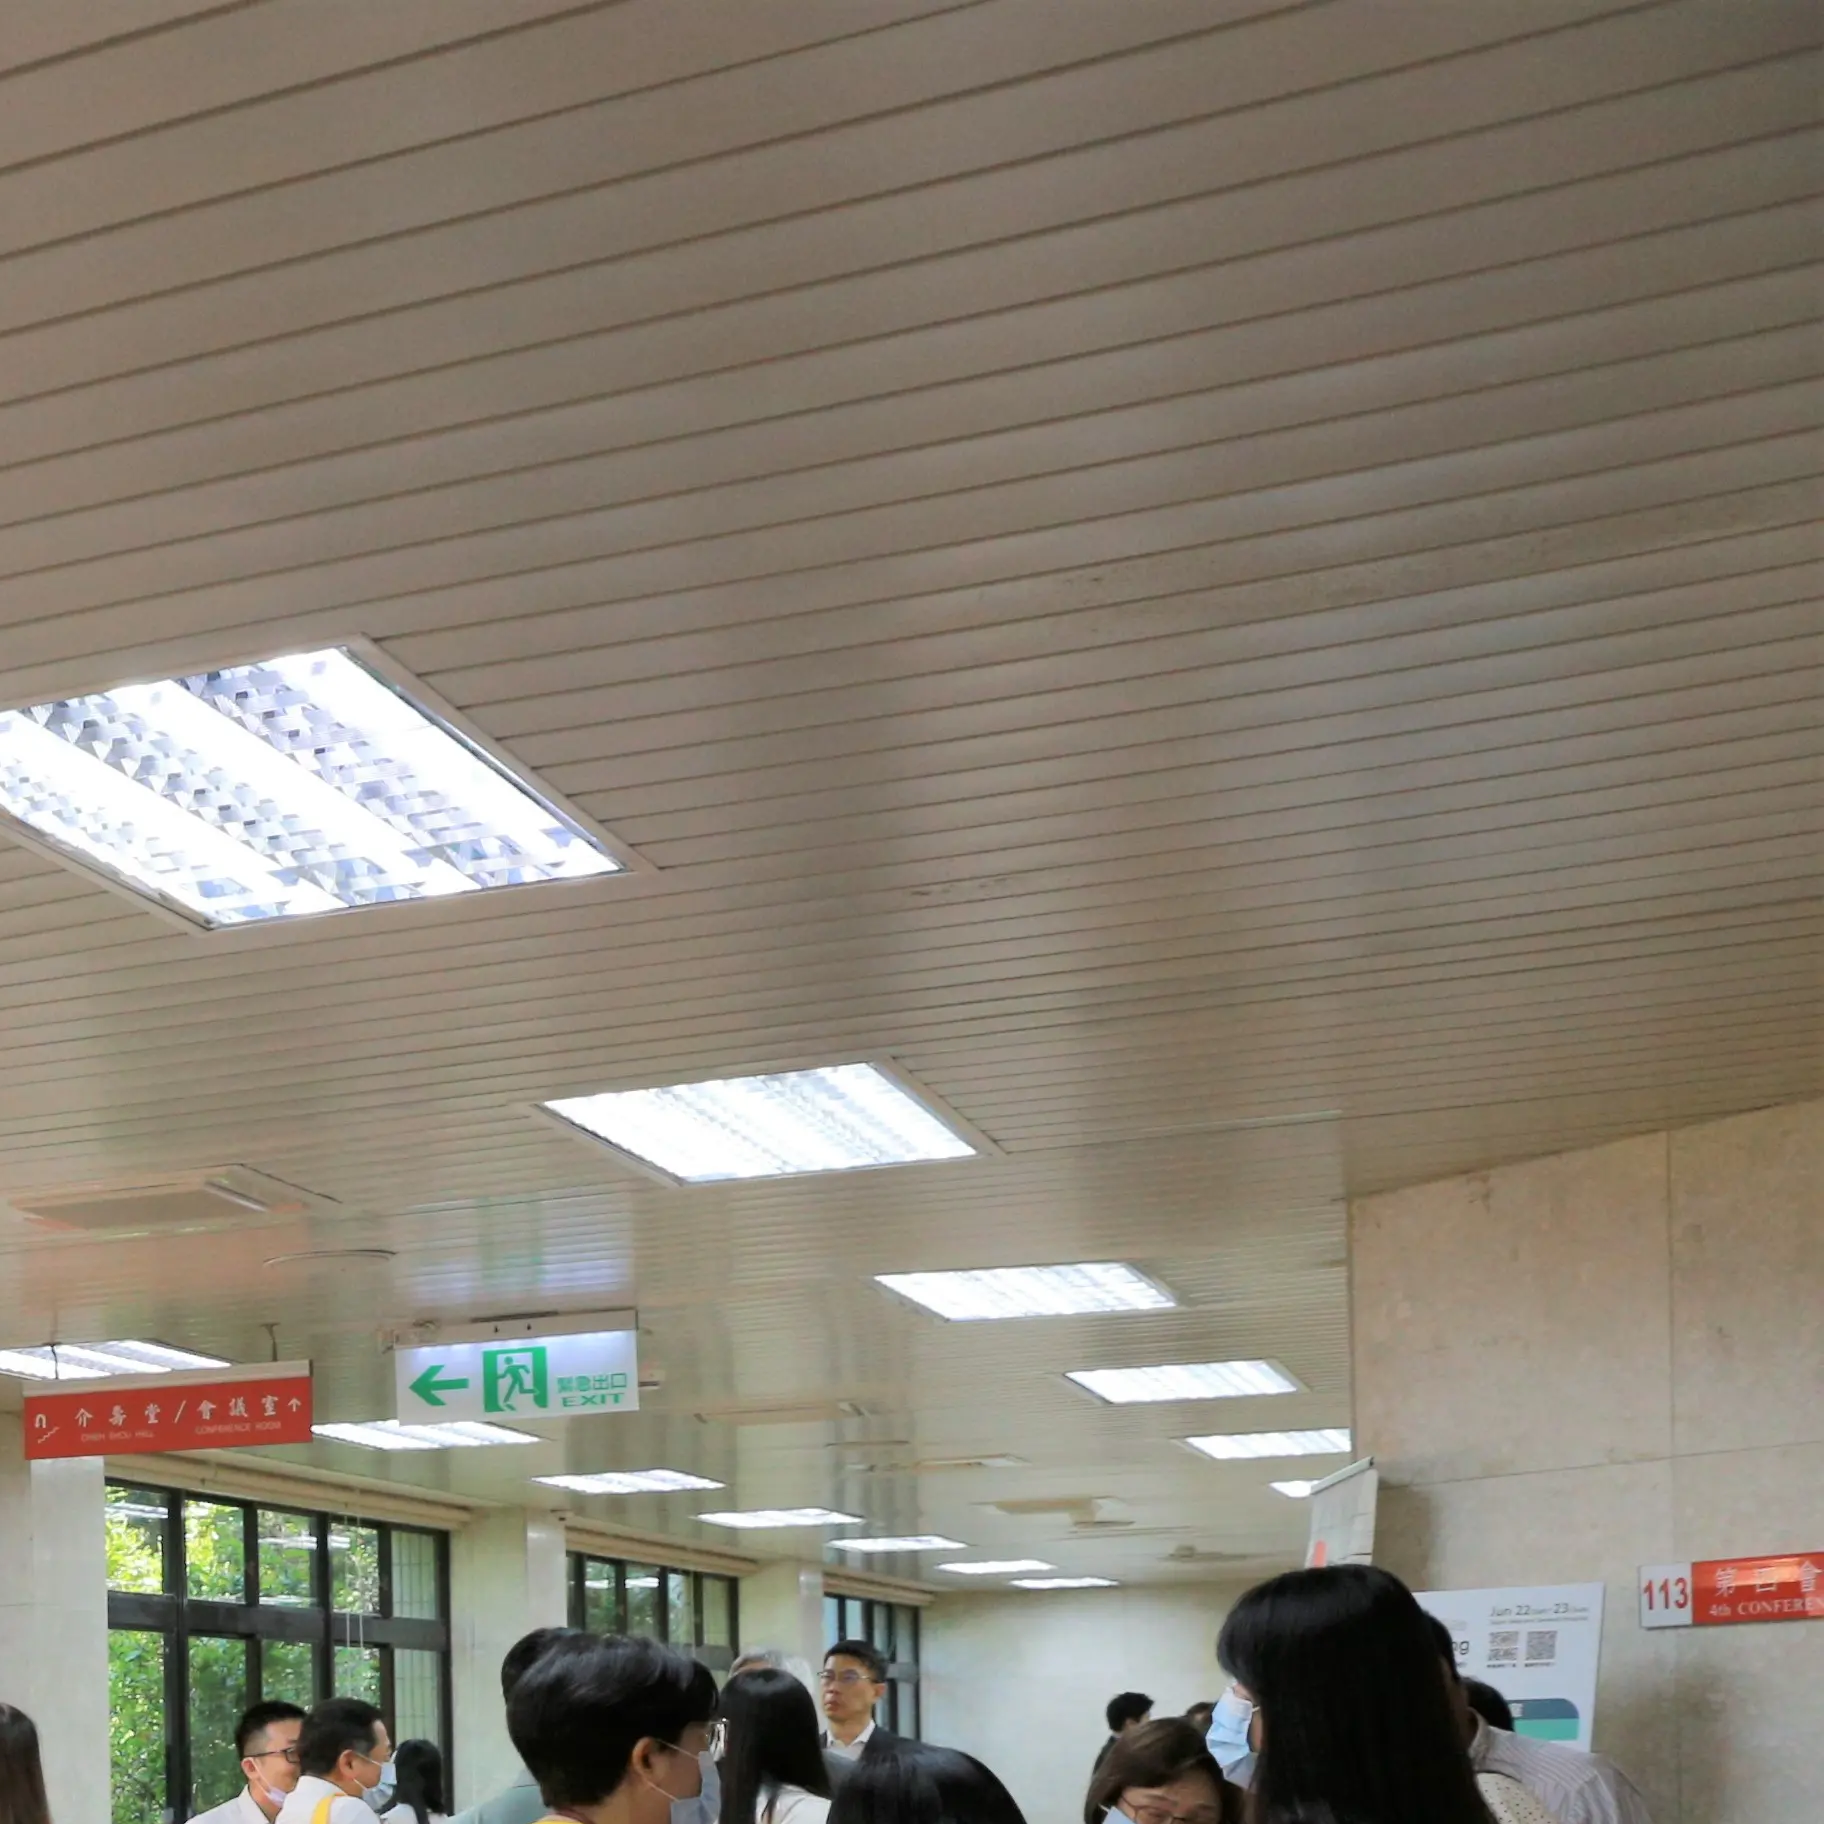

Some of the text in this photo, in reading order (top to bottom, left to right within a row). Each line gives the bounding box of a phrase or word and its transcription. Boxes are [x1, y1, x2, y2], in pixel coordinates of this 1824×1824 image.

[561, 1392, 625, 1407] EXIT
[195, 1421, 282, 1435] CONFERENCE ROOM
[1643, 1577, 1688, 1611] 113
[1490, 1606, 1512, 1617] Jun
[1709, 1603, 1731, 1617] 4th
